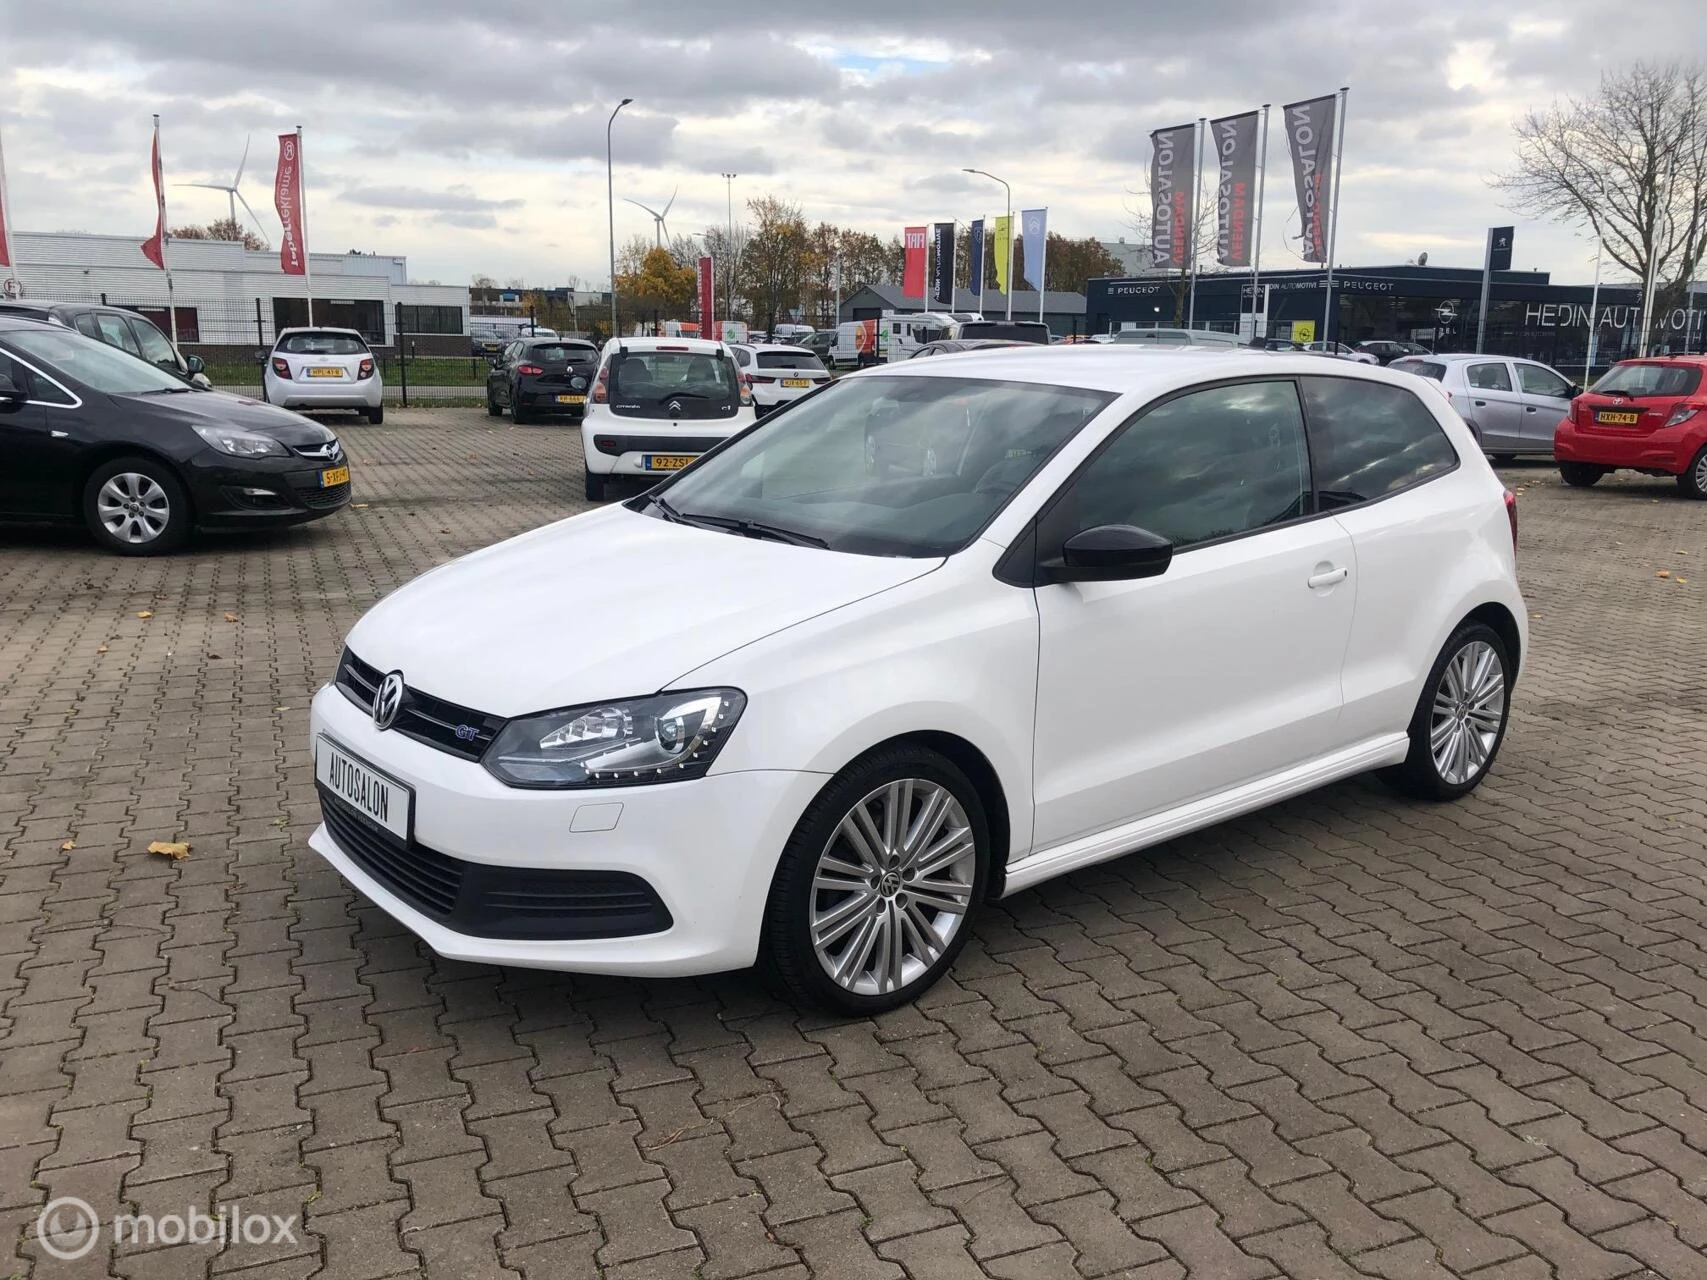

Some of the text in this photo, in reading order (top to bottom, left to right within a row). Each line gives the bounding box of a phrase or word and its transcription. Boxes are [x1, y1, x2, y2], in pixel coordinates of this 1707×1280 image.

[1117, 286, 1160, 294] PEUGEOT
[1343, 281, 1394, 291] PEUGEOT
[455, 723, 480, 741] GT
[329, 751, 389, 823] AUTOSALON
